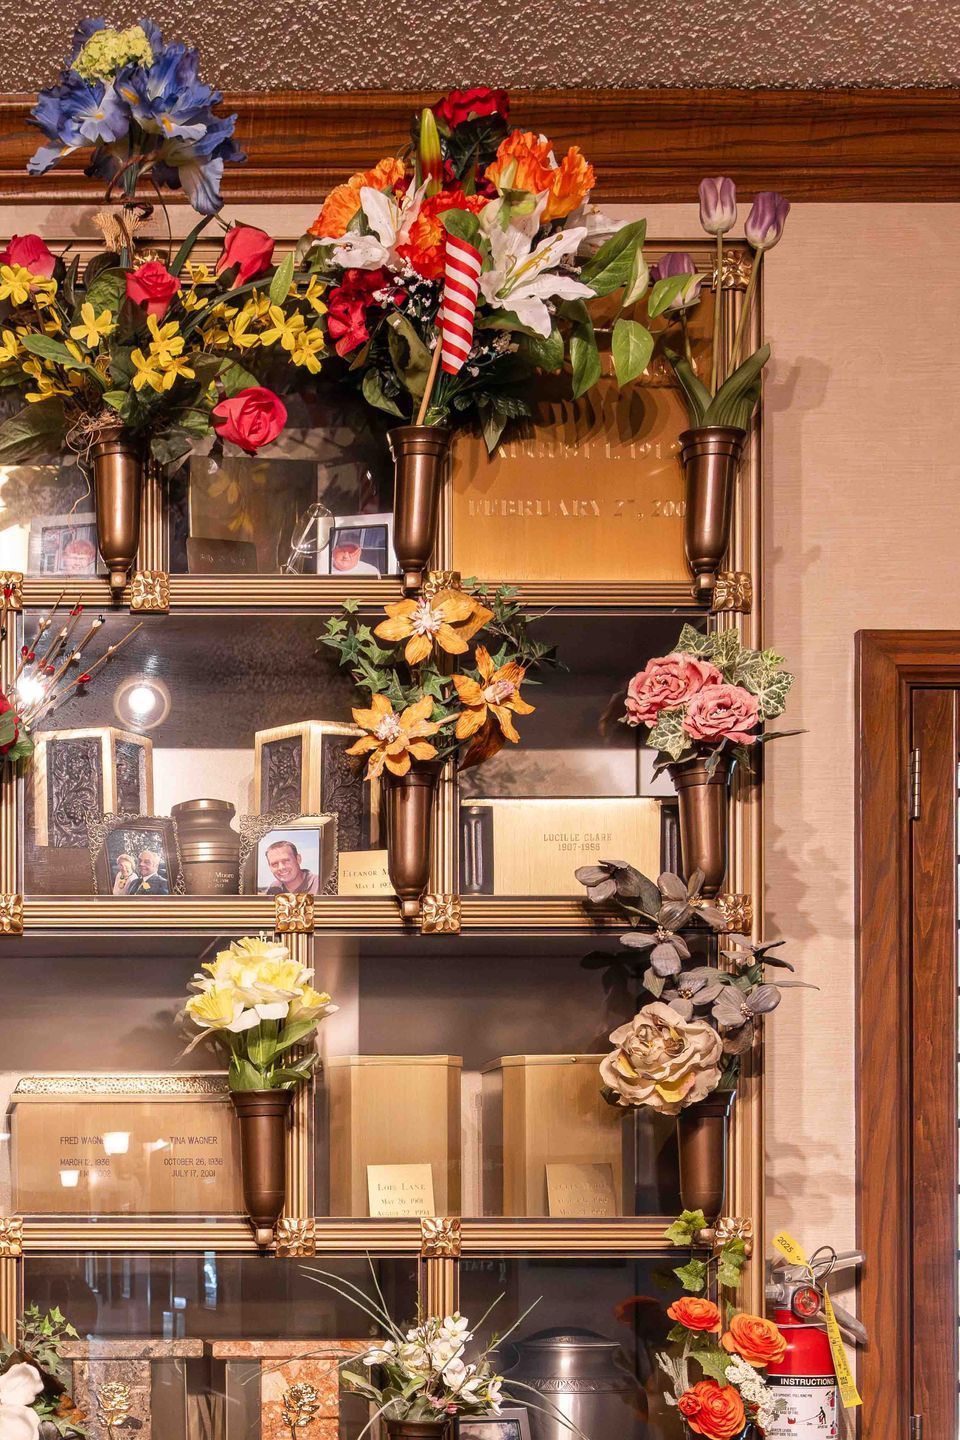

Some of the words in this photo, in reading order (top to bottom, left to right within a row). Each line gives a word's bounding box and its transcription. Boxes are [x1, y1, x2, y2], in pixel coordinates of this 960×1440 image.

[60, 1137, 79, 1145] FRED
[169, 1137, 186, 1145] TINA
[188, 1137, 218, 1145] WAGNER
[163, 1158, 194, 1166] OCTOBER
[171, 1170, 189, 1178] JULY
[776, 1236, 794, 1254] 2025
